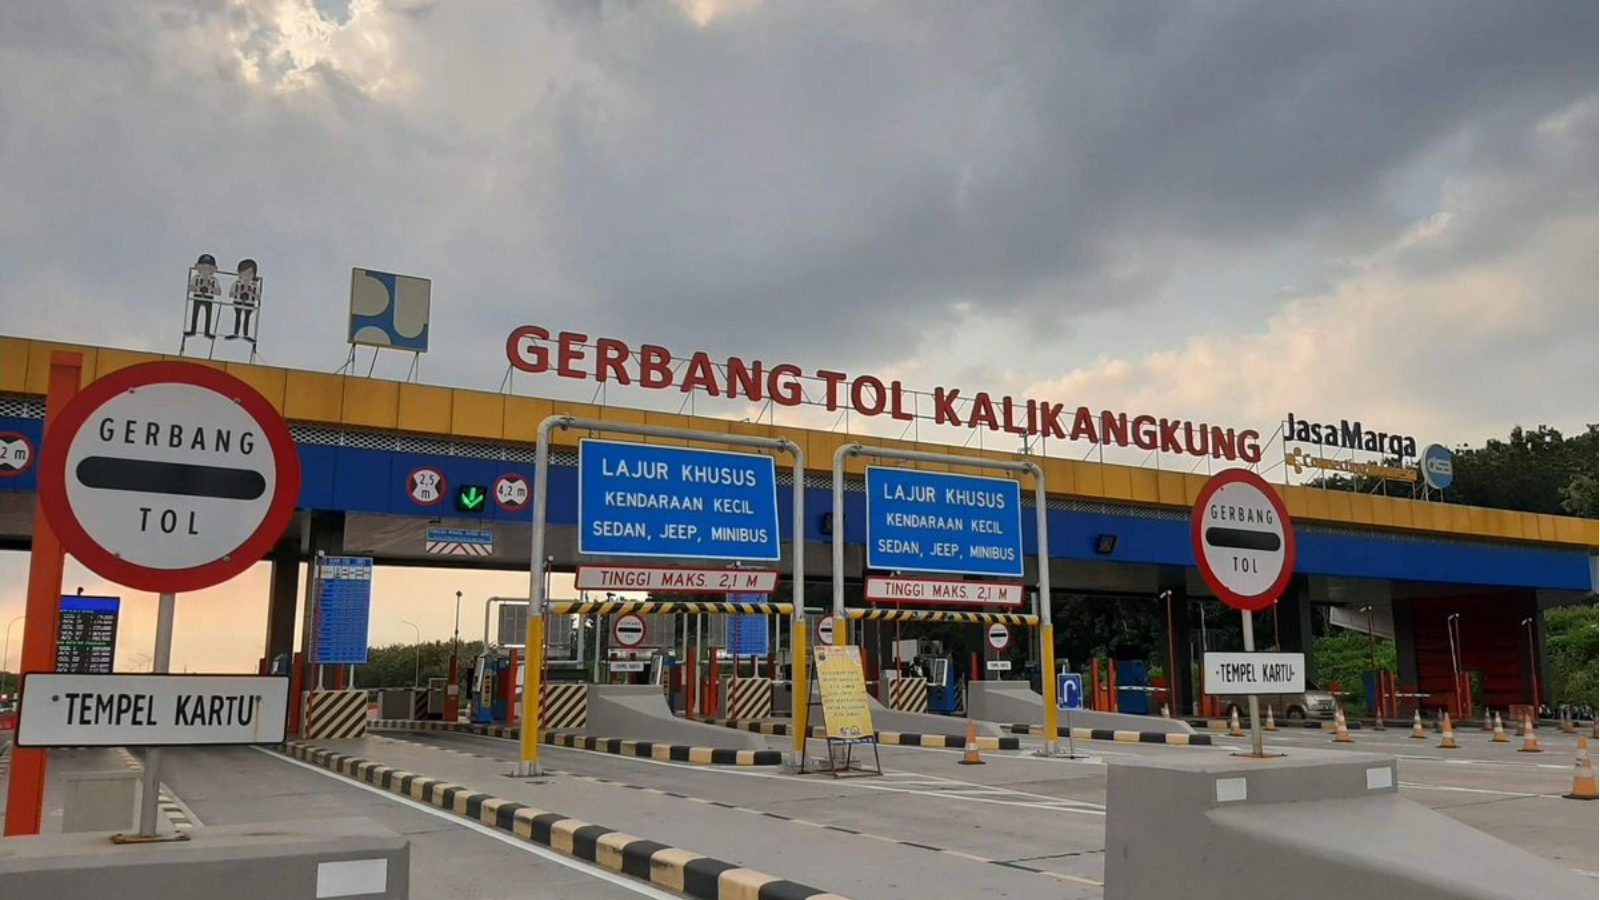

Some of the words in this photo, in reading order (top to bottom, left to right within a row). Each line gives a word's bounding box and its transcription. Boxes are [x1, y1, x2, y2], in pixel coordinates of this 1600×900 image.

[506, 324, 803, 407] GERBANG
[816, 369, 913, 421] TOL
[934, 386, 1261, 463] KALIKANGKUNG
[99, 417, 255, 455] GERBANG
[1284, 413, 1417, 462] JasaMarga
[14, 449, 26, 460] m
[419, 473, 435, 487] 2,5
[602, 458, 669, 480] LAJUR
[682, 465, 757, 487] KHUSUS
[420, 489, 431, 499] m
[498, 485, 513, 497] 4,2
[516, 487, 526, 497] m
[883, 483, 936, 503] LAJUR
[945, 489, 1005, 509] KHUSUS
[605, 491, 704, 511] KENDARAAN
[713, 498, 754, 515] KECIL
[139, 508, 199, 535] TOL
[886, 513, 964, 531] KENDARAAN
[971, 519, 1004, 534] KECIL
[1210, 504, 1273, 525] GERBANG
[592, 520, 652, 541] SEDAN,
[659, 524, 702, 543] JEEP,
[711, 526, 768, 544] MINIBUS
[878, 539, 924, 558] SEDAN,
[930, 542, 963, 560] JEEP,
[969, 545, 1015, 561] MINIBUS
[1233, 556, 1258, 574] TOL
[600, 570, 651, 587] TINGGI
[661, 572, 709, 588] MAKS.
[718, 573, 737, 590] 2,1
[746, 575, 758, 588] M
[885, 581, 925, 597] TINGGI
[932, 583, 969, 599] MAKS.
[977, 586, 992, 601] 2,1
[998, 588, 1008, 600] M
[1220, 663, 1257, 683] TEMPEL
[1262, 663, 1293, 683] KARTU
[65, 693, 158, 726] TEMPEL
[174, 694, 255, 727] KARTU
